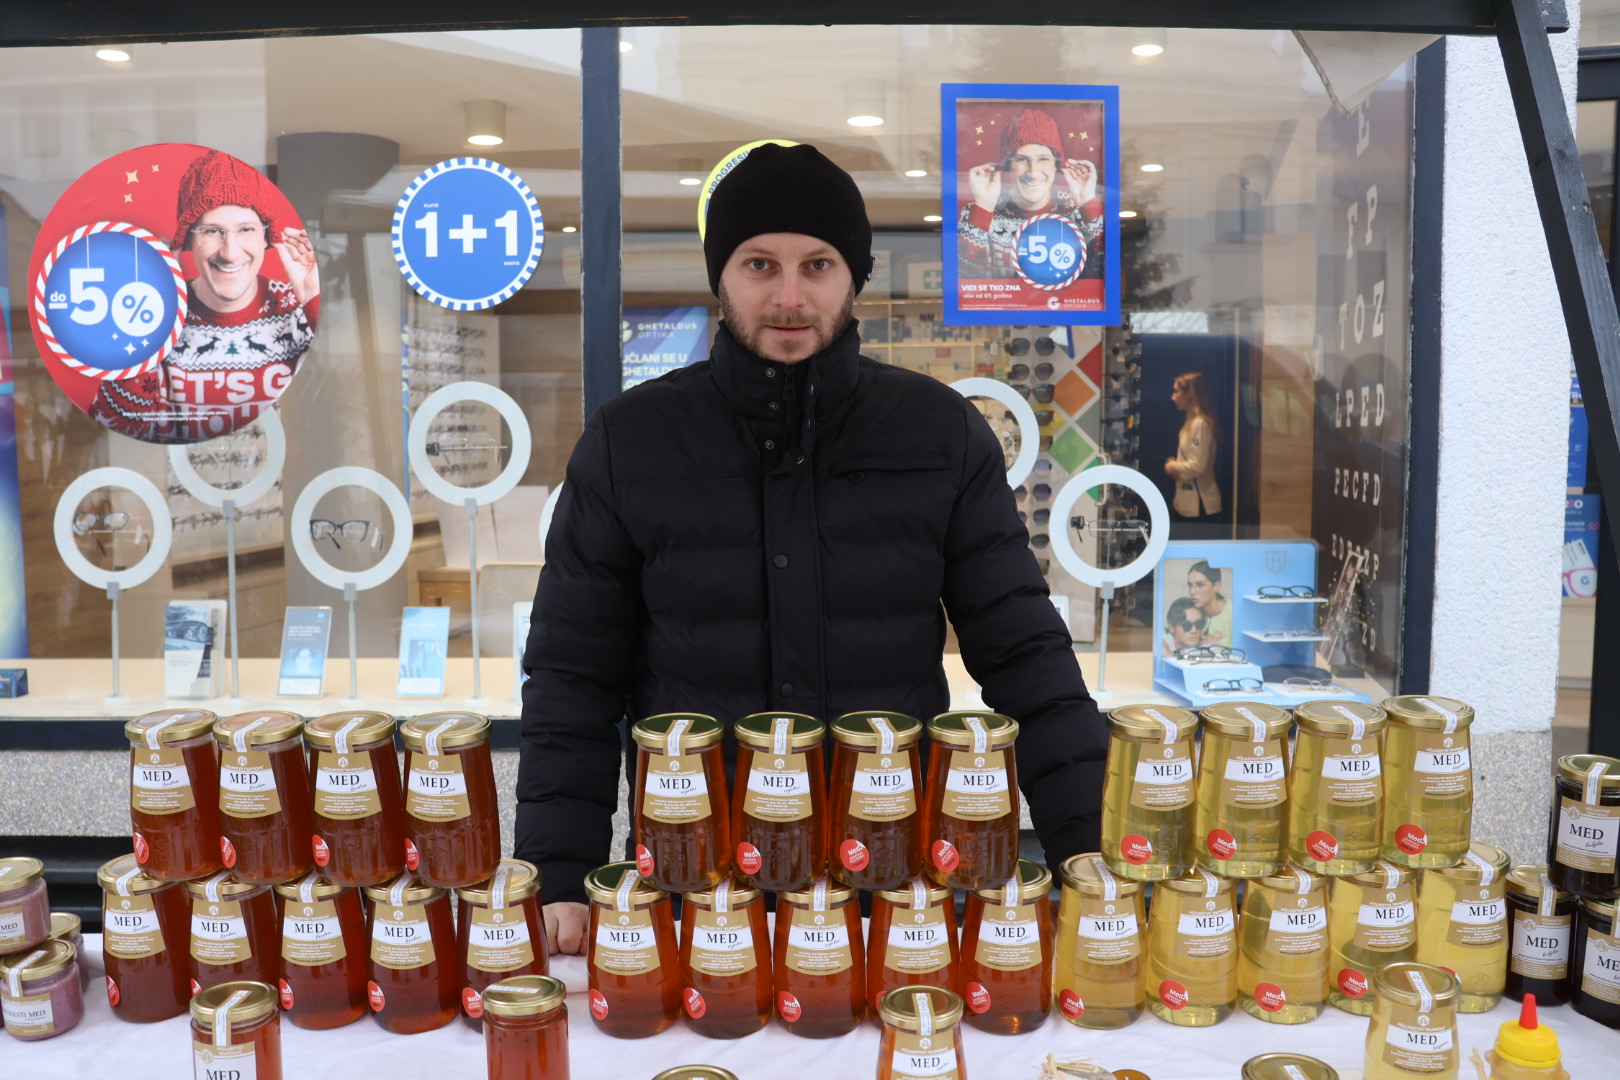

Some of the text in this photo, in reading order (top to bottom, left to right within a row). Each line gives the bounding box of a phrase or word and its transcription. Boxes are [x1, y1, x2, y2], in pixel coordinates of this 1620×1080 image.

[50, 290, 66, 302] do
[638, 322, 697, 330] GHETALDUS
[662, 353, 677, 362] SE
[678, 353, 688, 363] U
[1433, 754, 1461, 766] MED
[1153, 765, 1182, 776] MED
[1243, 763, 1272, 774] MED
[1340, 760, 1370, 772] MED
[143, 771, 171, 781] MED
[230, 773, 258, 784] MED
[329, 774, 360, 786] MED
[870, 775, 901, 786] MED
[963, 775, 994, 786] MED
[420, 776, 449, 788] MED
[660, 778, 691, 789] MED
[763, 776, 794, 788] MED
[1570, 824, 1604, 840] MED
[1376, 908, 1404, 919] MED
[1469, 904, 1497, 917] MED
[114, 916, 142, 926] MED
[1195, 916, 1224, 928] MED
[1287, 914, 1316, 925] MED
[1, 923, 18, 932] MED
[201, 922, 229, 932] MED
[295, 923, 324, 933] MED
[1094, 920, 1124, 931] MED
[385, 926, 414, 937] MED
[484, 929, 514, 940] MED
[610, 932, 640, 942] MED
[804, 932, 834, 942] MED
[904, 930, 934, 941] MED
[995, 927, 1025, 938] MED
[707, 933, 738, 944] MED
[1526, 934, 1558, 949] MED
[1597, 956, 1620, 971] ME
[29, 1010, 46, 1019] MED
[1407, 1033, 1437, 1045] MED
[911, 1057, 940, 1068] MED
[206, 1069, 240, 1080] MED
